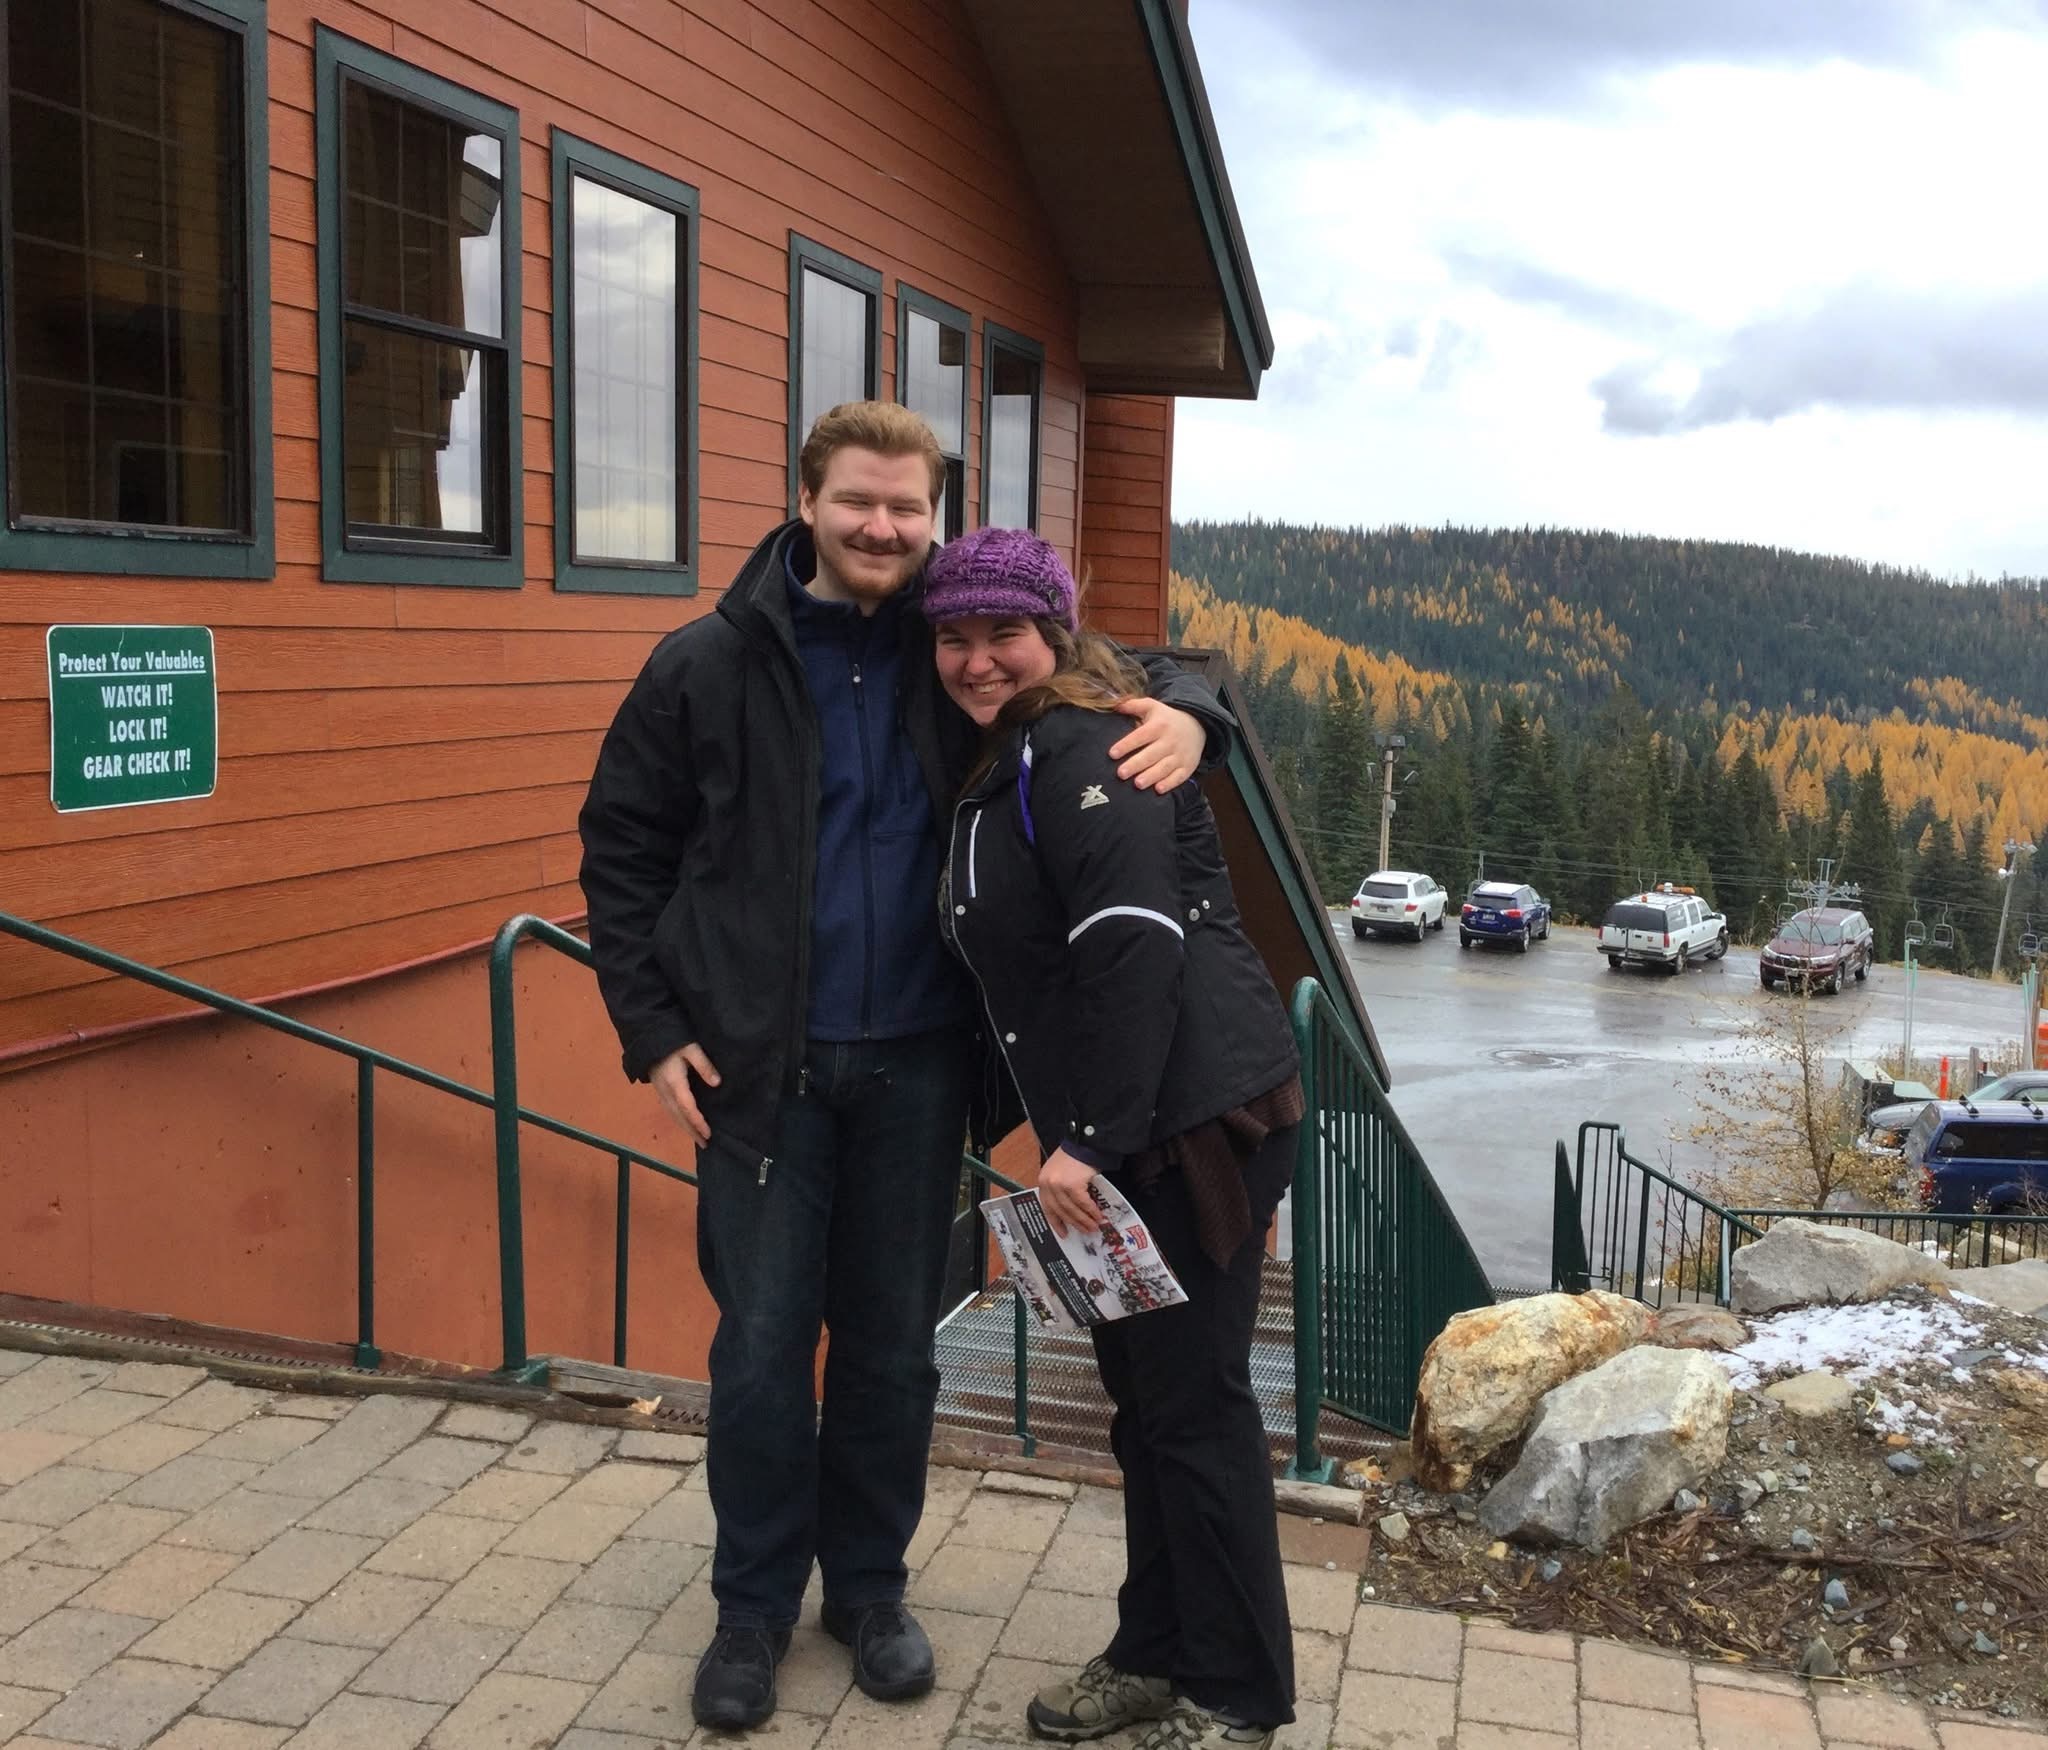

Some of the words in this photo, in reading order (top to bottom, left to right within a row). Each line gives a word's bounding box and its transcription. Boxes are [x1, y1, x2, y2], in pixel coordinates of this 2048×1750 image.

[58, 652, 107, 672] Protect
[111, 652, 142, 671] Your
[145, 650, 206, 671] Valuables
[101, 684, 152, 708] WATCH
[156, 682, 173, 706] IT!
[109, 719, 146, 743] LOCK
[150, 716, 167, 740] IT!
[83, 755, 123, 779] GEAR
[127, 751, 170, 775] CHECK
[174, 747, 191, 771] IT!
[1087, 1182, 1110, 1210] OUR
